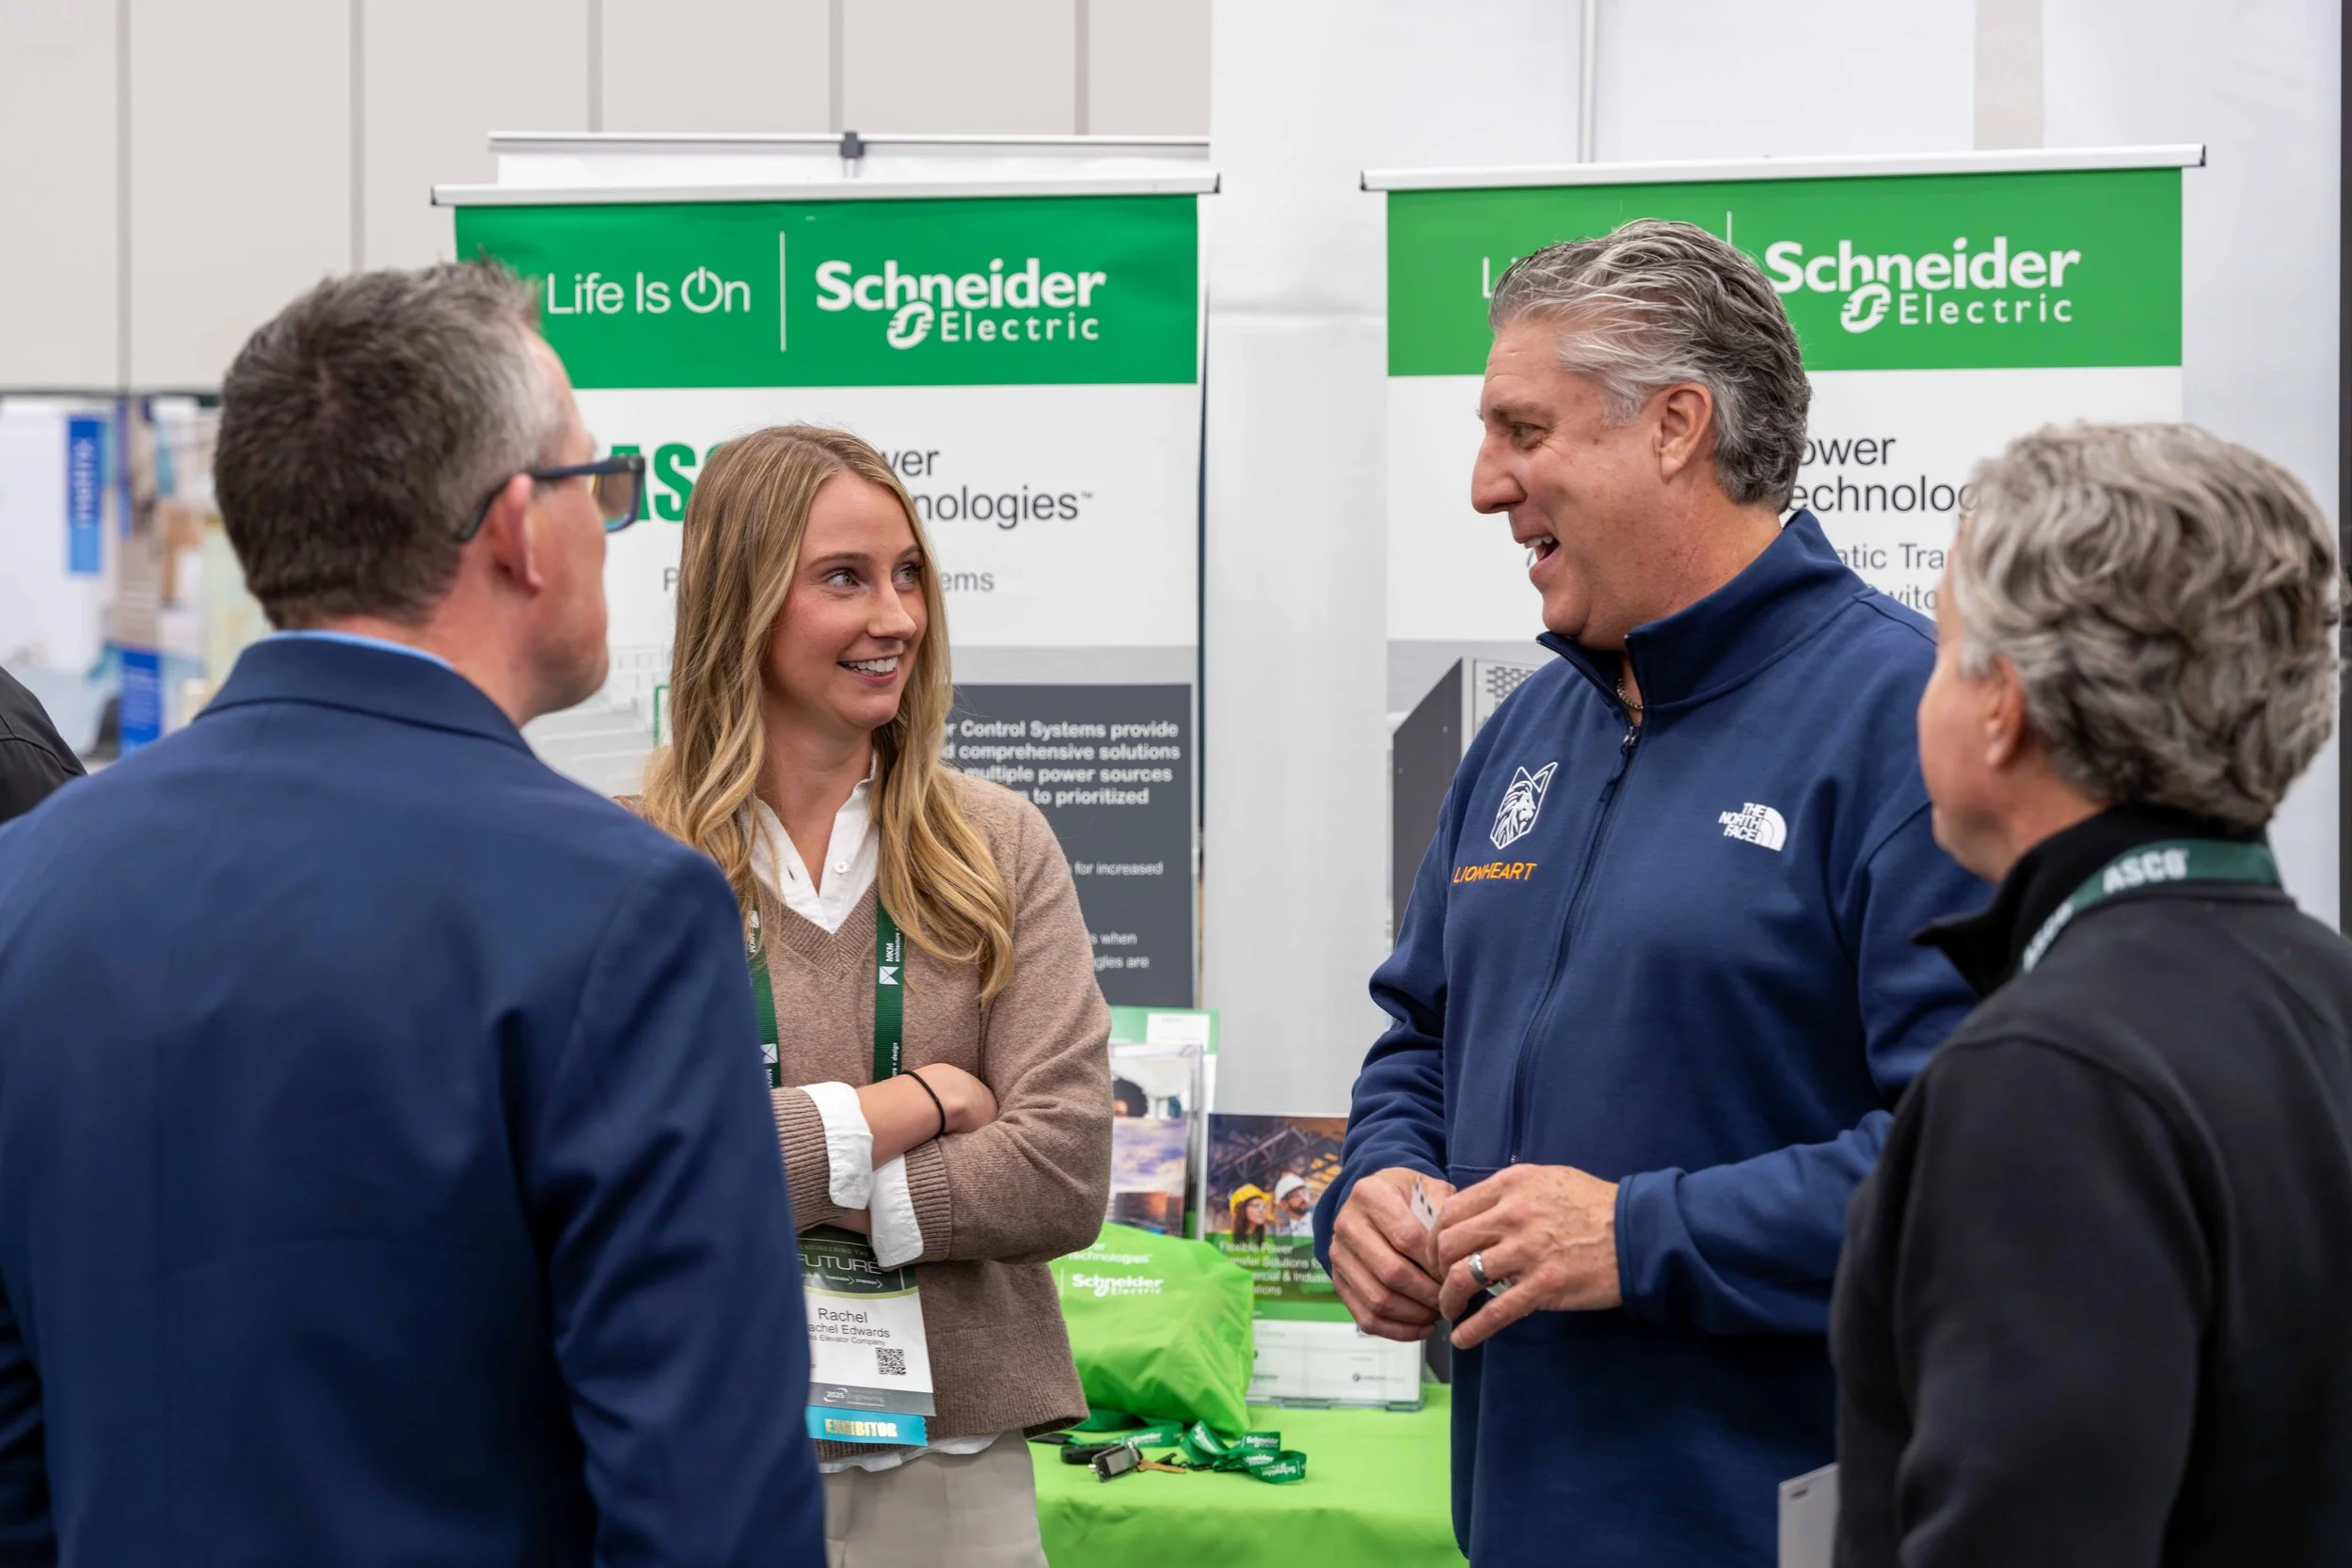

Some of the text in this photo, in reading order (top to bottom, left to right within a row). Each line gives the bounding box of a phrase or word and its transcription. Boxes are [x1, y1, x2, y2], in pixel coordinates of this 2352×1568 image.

[1765, 236, 2081, 293] Schneider
[547, 266, 751, 315] Life Is On
[815, 258, 1106, 310] Schneider
[1899, 293, 2073, 325] Electric
[941, 311, 1099, 342] Electric
[1800, 437, 1897, 466] ower
[961, 719, 1025, 738] Control
[1029, 720, 1106, 741] Systems
[1110, 720, 1179, 741] provide
[958, 742, 1095, 763] comprehensive
[1099, 743, 1182, 761] solutions
[1038, 767, 1096, 785] power
[1099, 768, 1173, 783] sources
[1033, 786, 1052, 804] to
[1055, 787, 1150, 808] prioritized
[1742, 802, 1767, 818] THE
[1718, 811, 1761, 830] NORTH
[1723, 824, 1758, 843] FACE
[1074, 861, 1164, 876] for increased
[1453, 861, 1537, 883] LIONHEART
[885, 942, 894, 962] MKM
[1261, 1242, 1294, 1255] Power
[1281, 1269, 1292, 1282] &
[818, 1307, 867, 1323] Rachel
[807, 1323, 891, 1338] achel Edwards
[819, 1334, 850, 1343] Elevator
[850, 1337, 885, 1347] Company
[824, 1418, 898, 1438] EXHIBITOR
